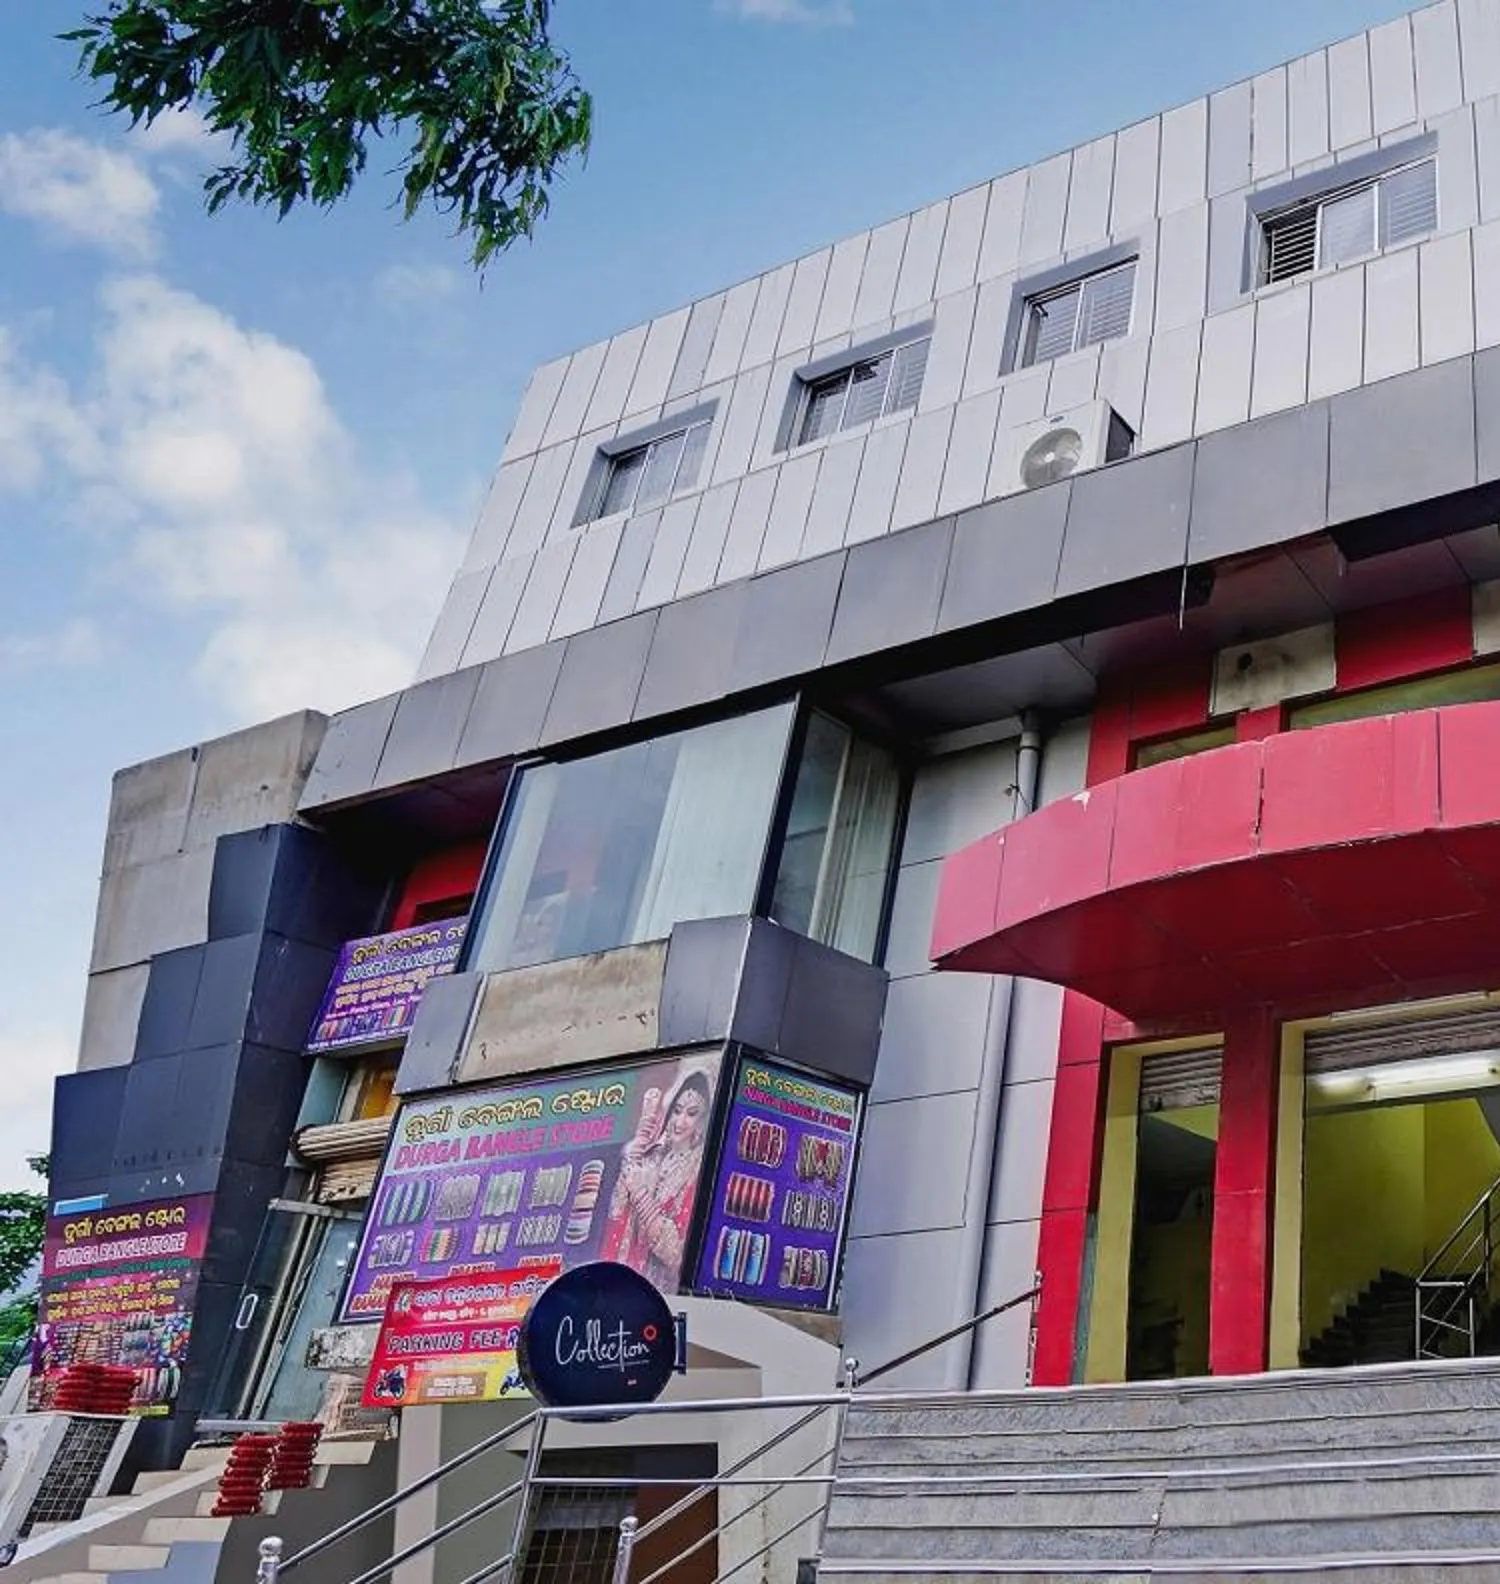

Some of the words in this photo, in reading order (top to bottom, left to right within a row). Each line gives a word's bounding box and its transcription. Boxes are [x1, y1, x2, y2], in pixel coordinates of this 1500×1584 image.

[394, 1137, 462, 1169] DURGA
[464, 1125, 545, 1160] BANGLE
[551, 1115, 616, 1145] STORE
[55, 1244, 99, 1268] DURGA
[100, 1238, 147, 1262] BANGLE
[147, 1232, 188, 1255] STORE
[387, 1332, 464, 1355] PARKING
[555, 1315, 651, 1373] Collection
